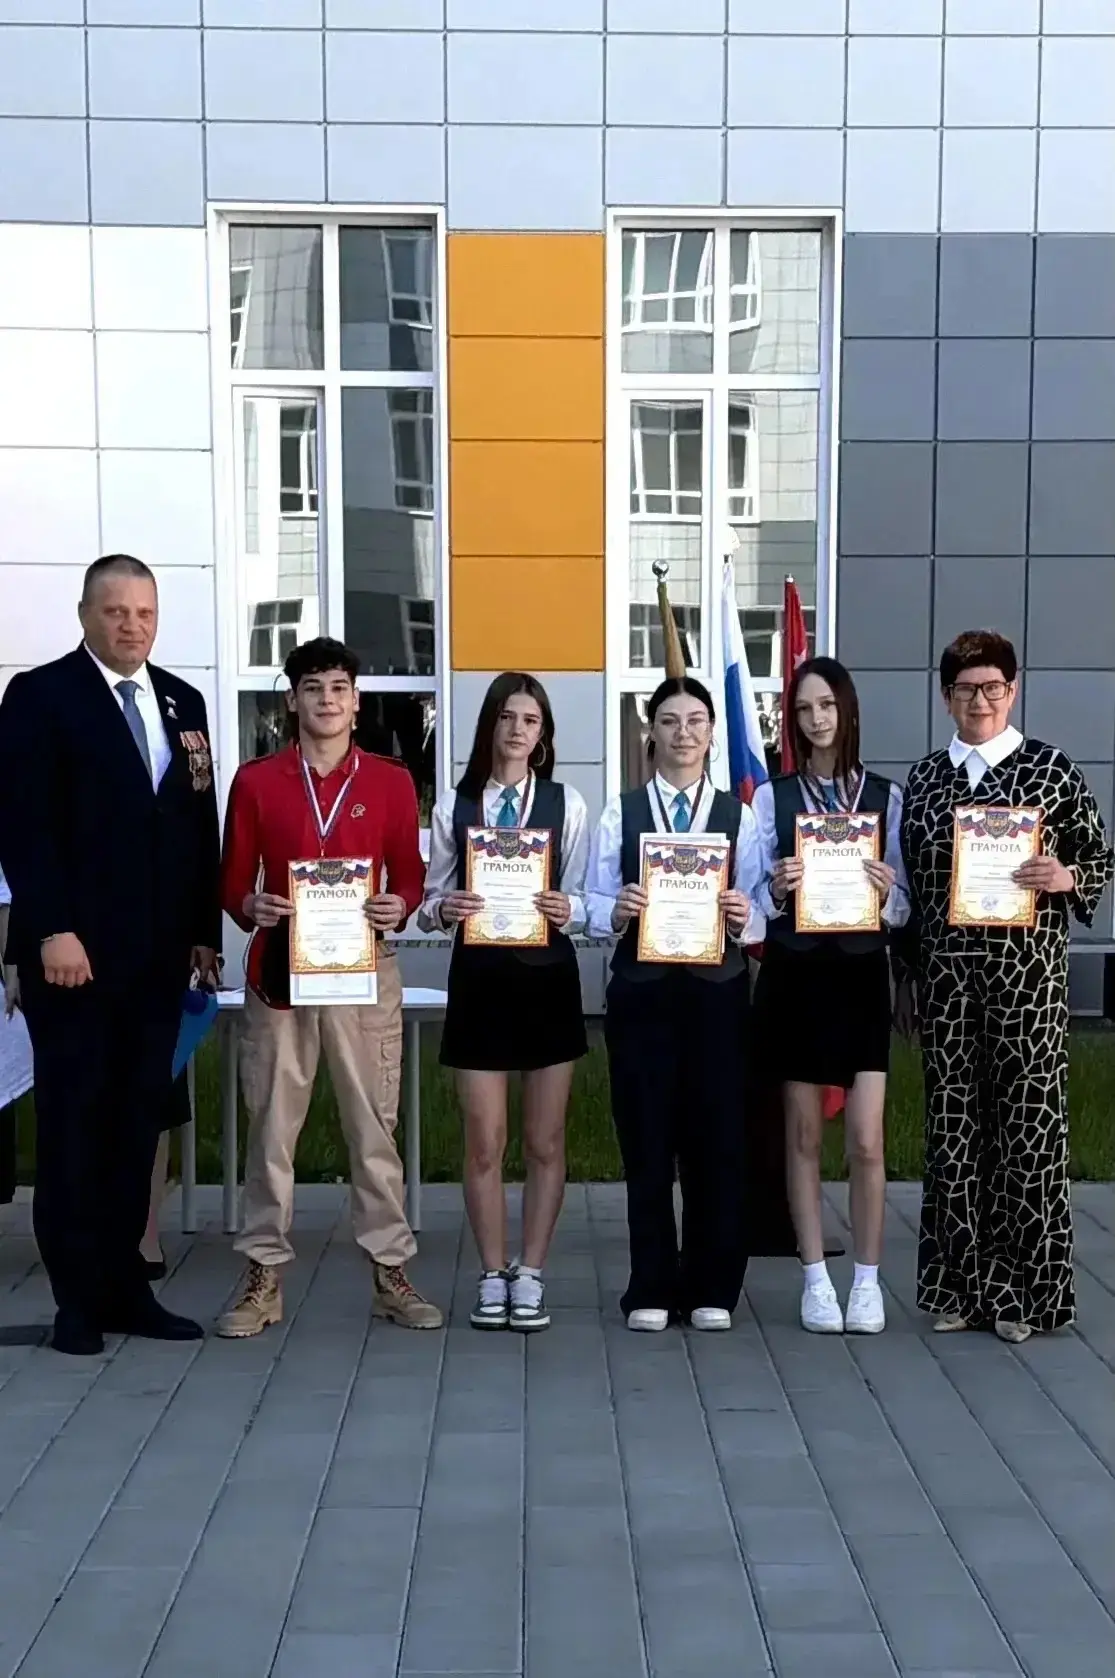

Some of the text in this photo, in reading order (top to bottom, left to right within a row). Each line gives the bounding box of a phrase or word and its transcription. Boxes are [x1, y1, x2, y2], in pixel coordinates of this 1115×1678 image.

[812, 847, 863, 858] ГРАМОТА
[970, 842, 1022, 853] ГРАМОТА
[483, 862, 533, 873] ГРАМОТА
[659, 878, 709, 891] ГРАМОТА
[306, 889, 358, 900] ГРАМОТА
